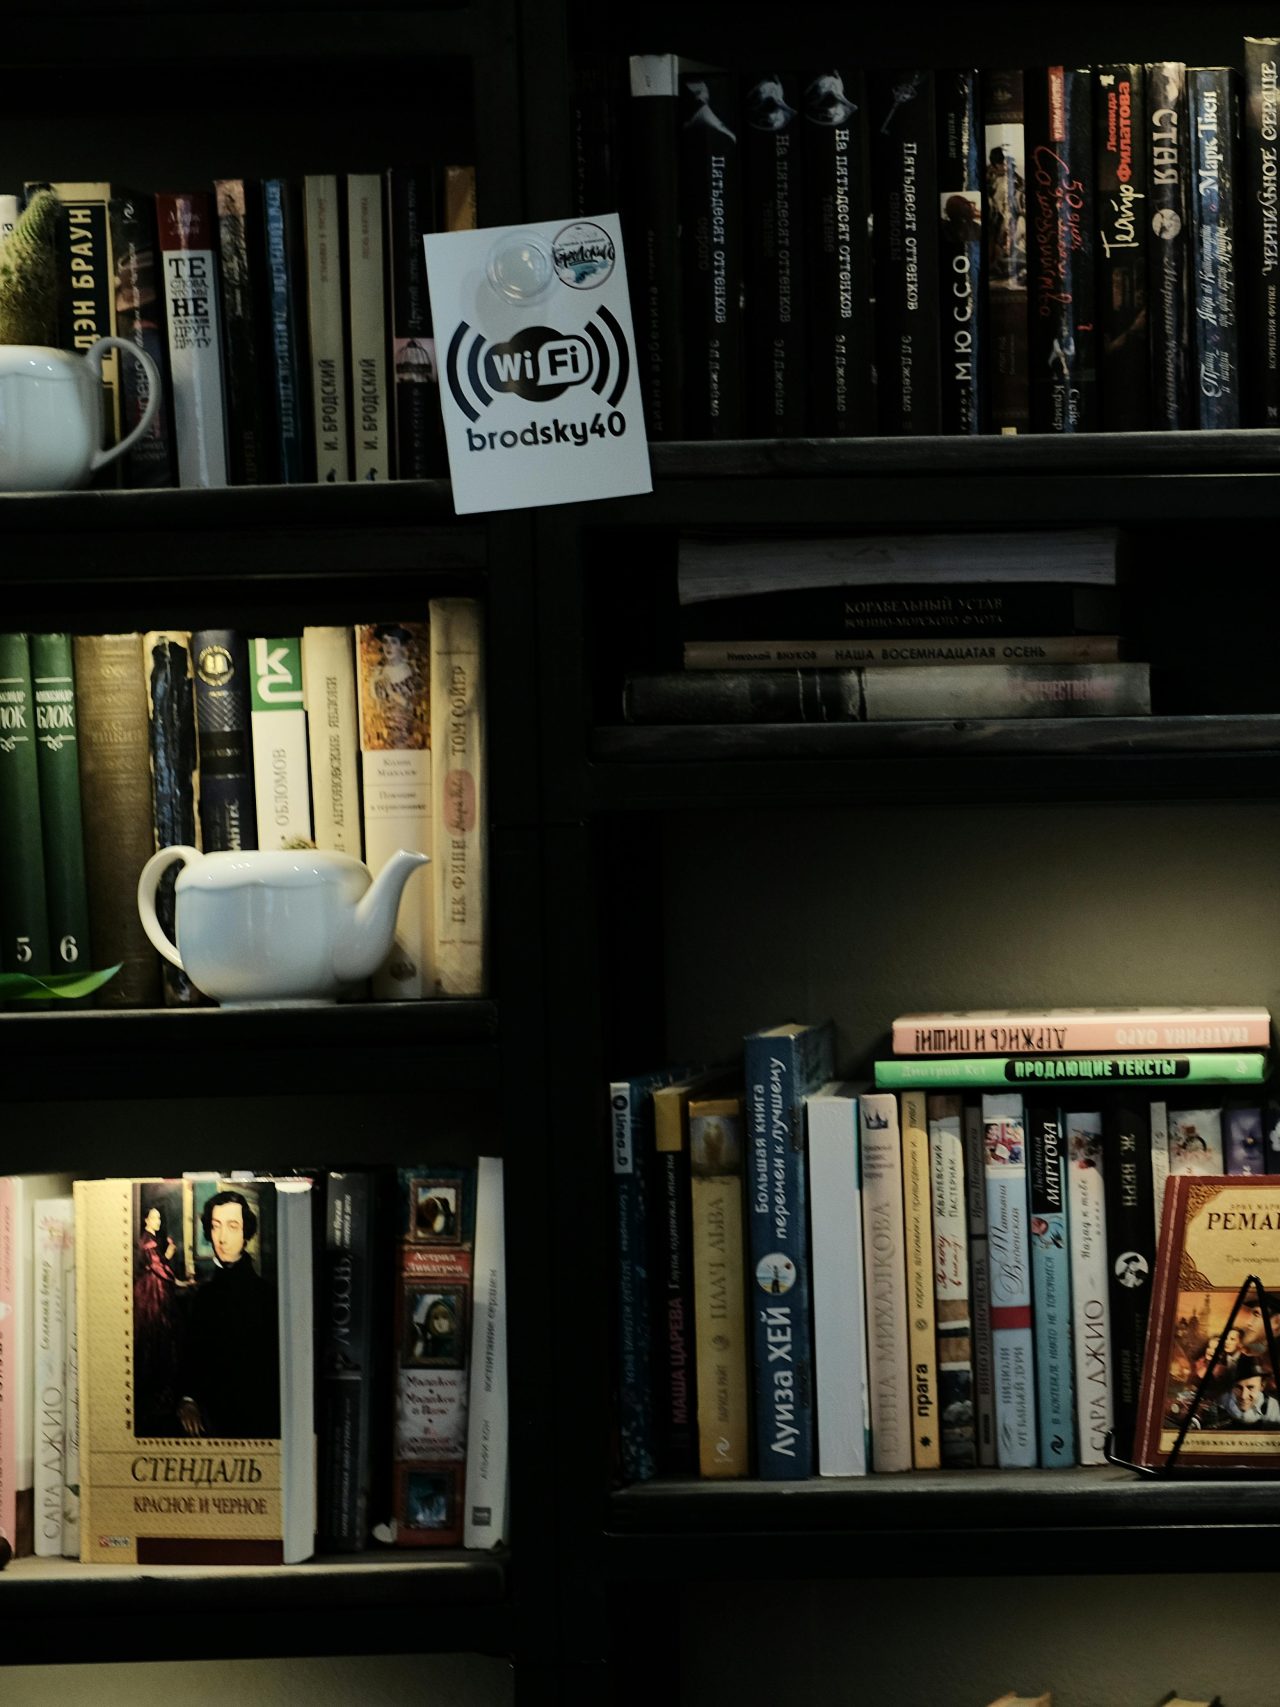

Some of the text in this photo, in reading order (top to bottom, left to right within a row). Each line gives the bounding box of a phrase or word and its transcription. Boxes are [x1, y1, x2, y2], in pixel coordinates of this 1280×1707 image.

[1106, 92, 1120, 153] Леонида
[1114, 80, 1132, 183] Филатова
[1152, 106, 1180, 186] СТАЯ
[1198, 91, 1223, 195] Марк Твен
[835, 155, 852, 242] пятьдесят
[902, 141, 920, 311] Пятьдесят оттенков
[1101, 184, 1146, 257] Театр
[69, 208, 101, 350] ДЭН БРАУН
[169, 257, 206, 279] ТЕ
[711, 250, 726, 325] оттенков
[778, 250, 793, 324] оттенков
[838, 245, 855, 320] оттенков
[173, 298, 209, 317] НЕ
[953, 255, 973, 381] МЮССО
[493, 344, 580, 384] WiFi
[319, 358, 339, 452] И. БРОДСКИЙ
[360, 358, 383, 452] И. БРОДСКИЙ
[467, 411, 626, 451] brodsky40
[727, 645, 1047, 663] Николай НАША ВОСЕМНАДЦАТАЯ ОСЕНЬ
[36, 706, 75, 729] БЛОК
[448, 665, 468, 756] ТОМ СОЙЕР
[271, 749, 292, 827] ОБЛОМОВ
[17, 936, 33, 963] 5
[59, 935, 79, 964] 6
[914, 1027, 1069, 1053] ДЕРЖИСЬ ПИШИ!
[1013, 1057, 1178, 1081] ПРОДАЮЩИЕ ТЕКСТЫ
[752, 1083, 771, 1214] Большая книга
[767, 1057, 790, 1242] перемен к лучшему
[1042, 1121, 1061, 1207] МАРТОВА
[1119, 1162, 1138, 1207] ВЕРН
[871, 1202, 897, 1365] МИХАЛКОВА
[666, 1296, 690, 1425] МАША ЦАРЕВА
[759, 1306, 801, 1457] Луиза ХЕЙ
[911, 1363, 929, 1418] прага
[1083, 1300, 1108, 1451] САРА ДЖИО
[40, 1386, 64, 1540] САРА ДЖИО
[131, 1456, 263, 1488] СТЕНДАЛЬ
[133, 1496, 268, 1515] КРАСНОЕ И ЧЕРНОЕ
